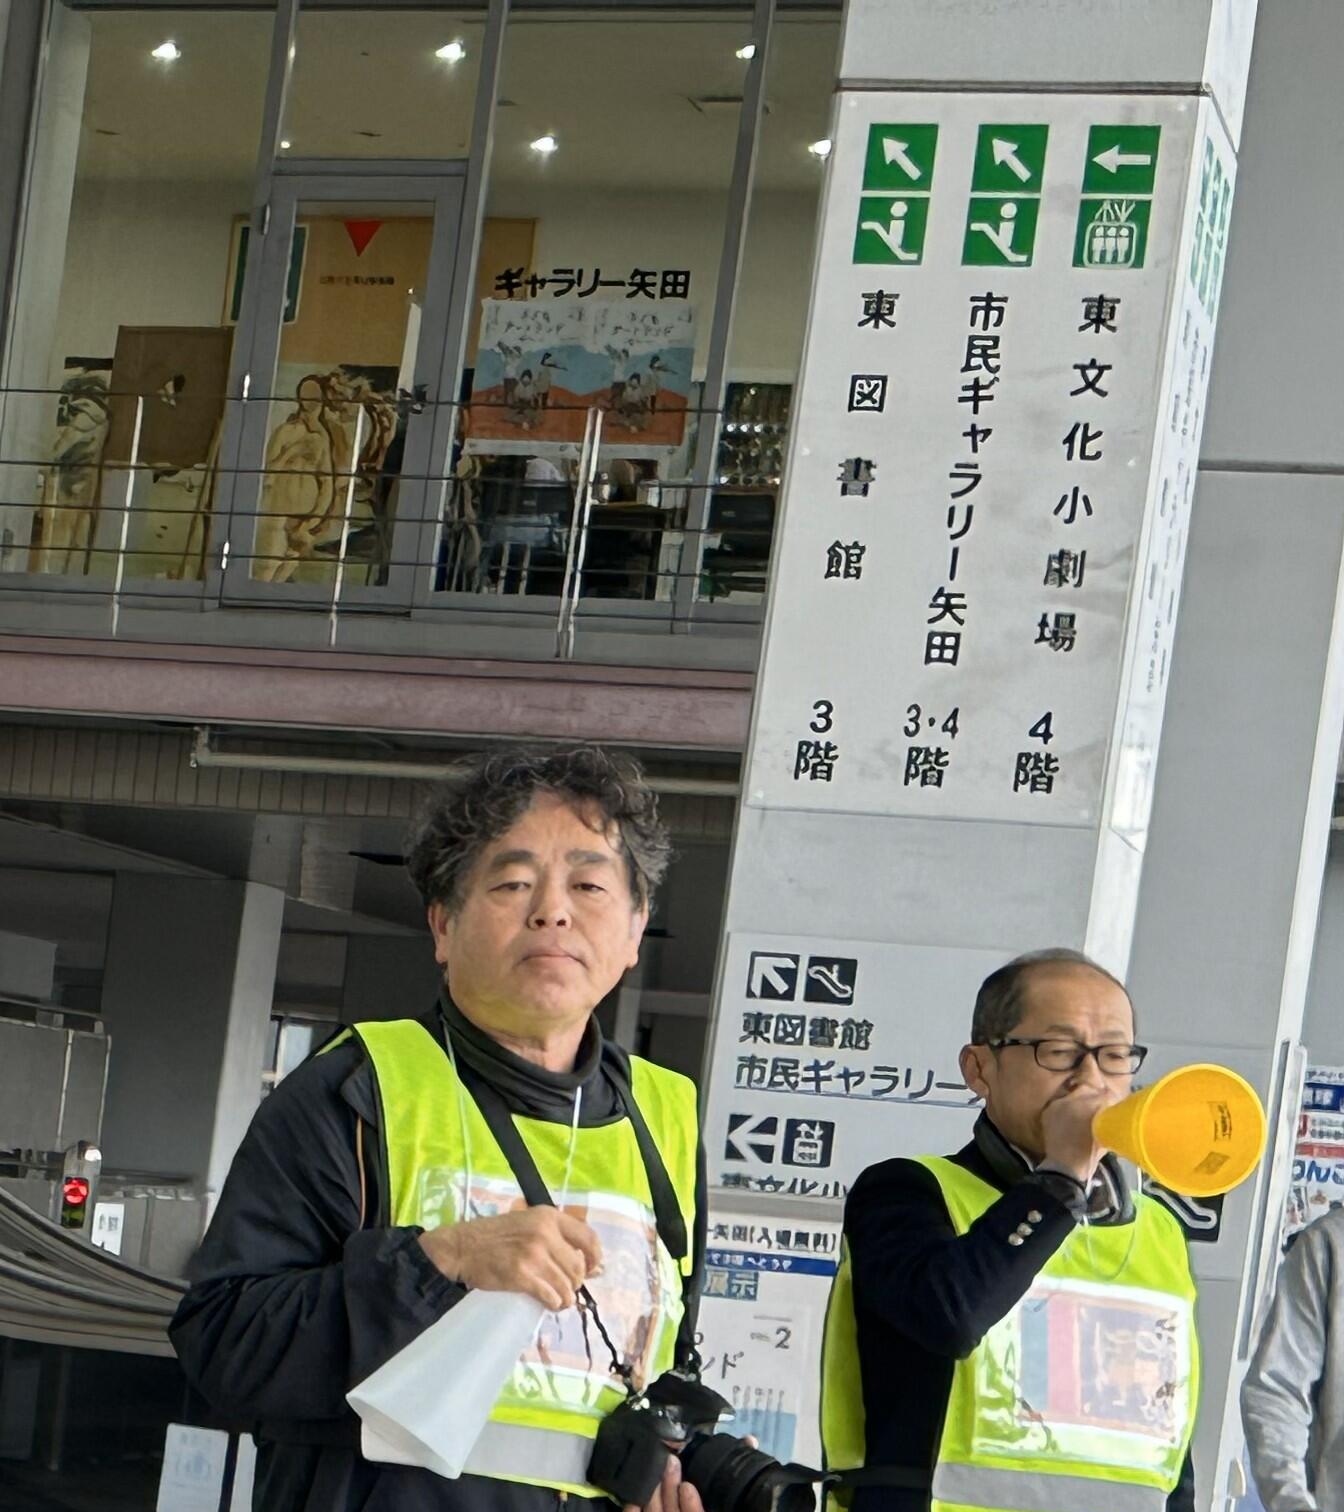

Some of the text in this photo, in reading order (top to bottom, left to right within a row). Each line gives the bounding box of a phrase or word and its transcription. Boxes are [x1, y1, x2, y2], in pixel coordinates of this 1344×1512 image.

[494, 267, 691, 300] ギャラリー矢田
[793, 289, 901, 783] 東図書館 3階
[923, 290, 1010, 667] 市民ギャラリー矢田
[1012, 293, 1122, 795] 東文化小劇場 4階
[735, 1053, 985, 1105] 市民ギャラリー
[738, 1010, 875, 1051] 東図書館
